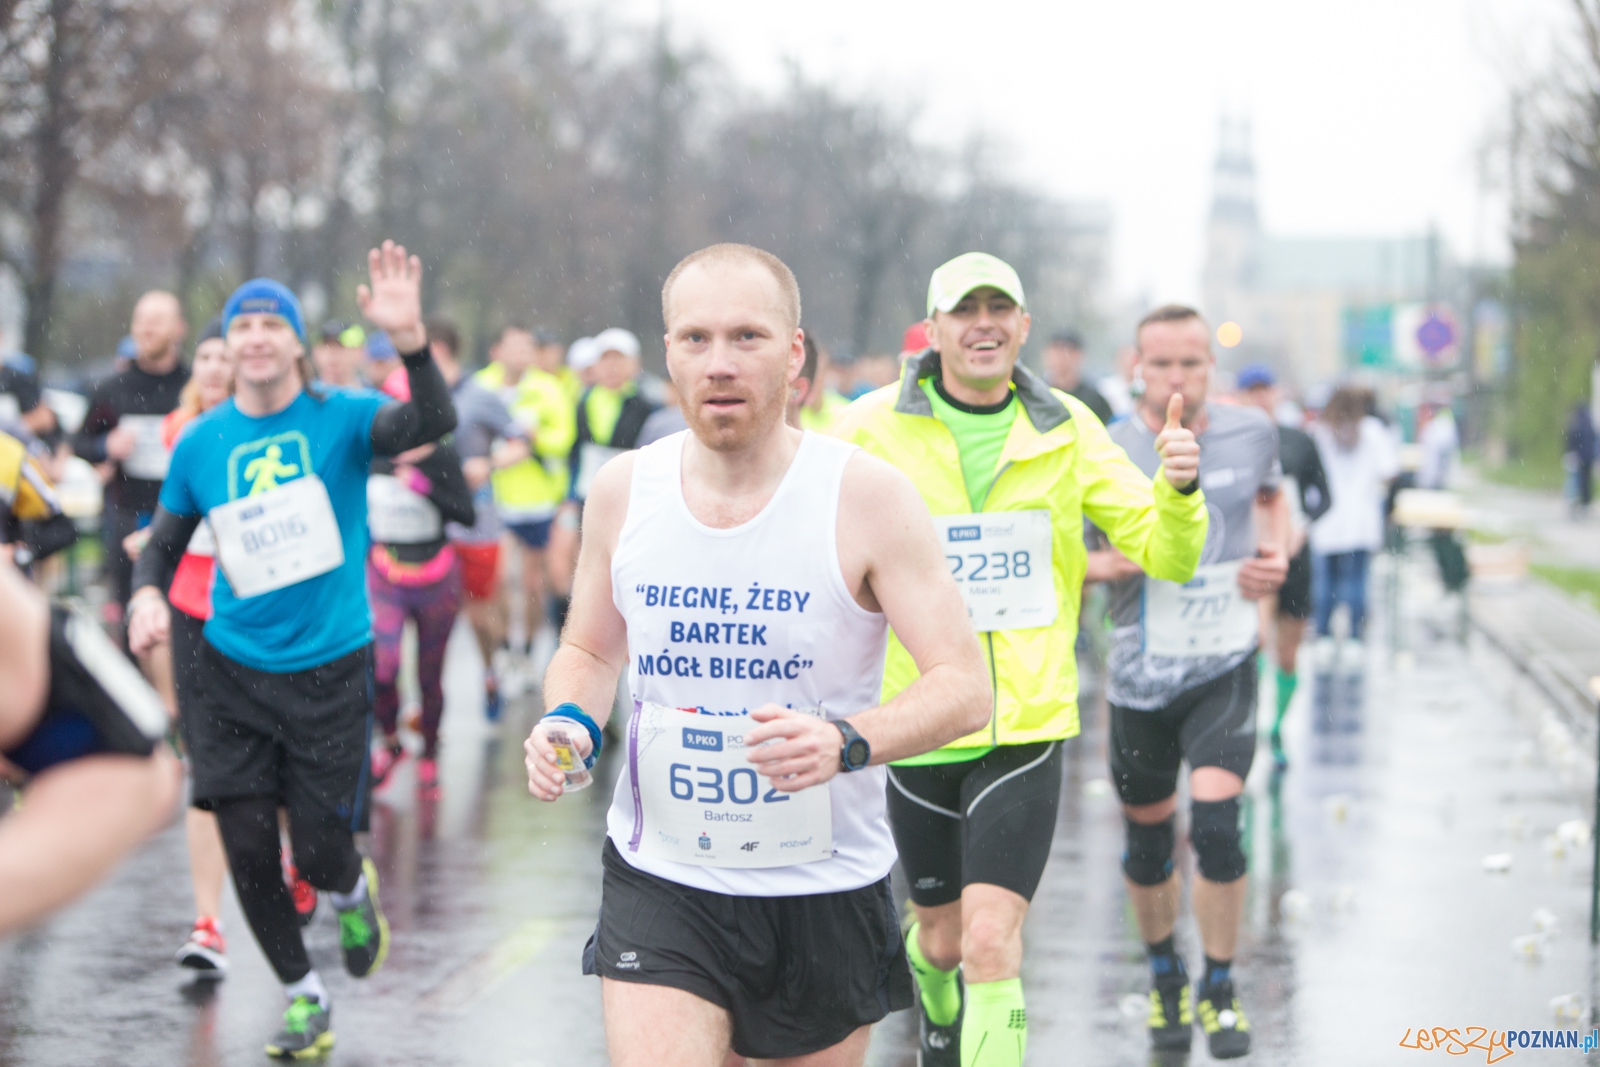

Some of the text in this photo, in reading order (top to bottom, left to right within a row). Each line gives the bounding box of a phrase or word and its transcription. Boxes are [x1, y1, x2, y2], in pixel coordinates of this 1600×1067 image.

[240, 512, 307, 555] 8016
[945, 550, 1031, 582] 2238
[746, 581, 811, 613] ŻEBY
[670, 621, 767, 646] BARTEK
[638, 648, 814, 680] MÓGŁ BIEGAĆ”
[686, 733, 717, 746] 9.PKO
[704, 810, 754, 823] Bartosz
